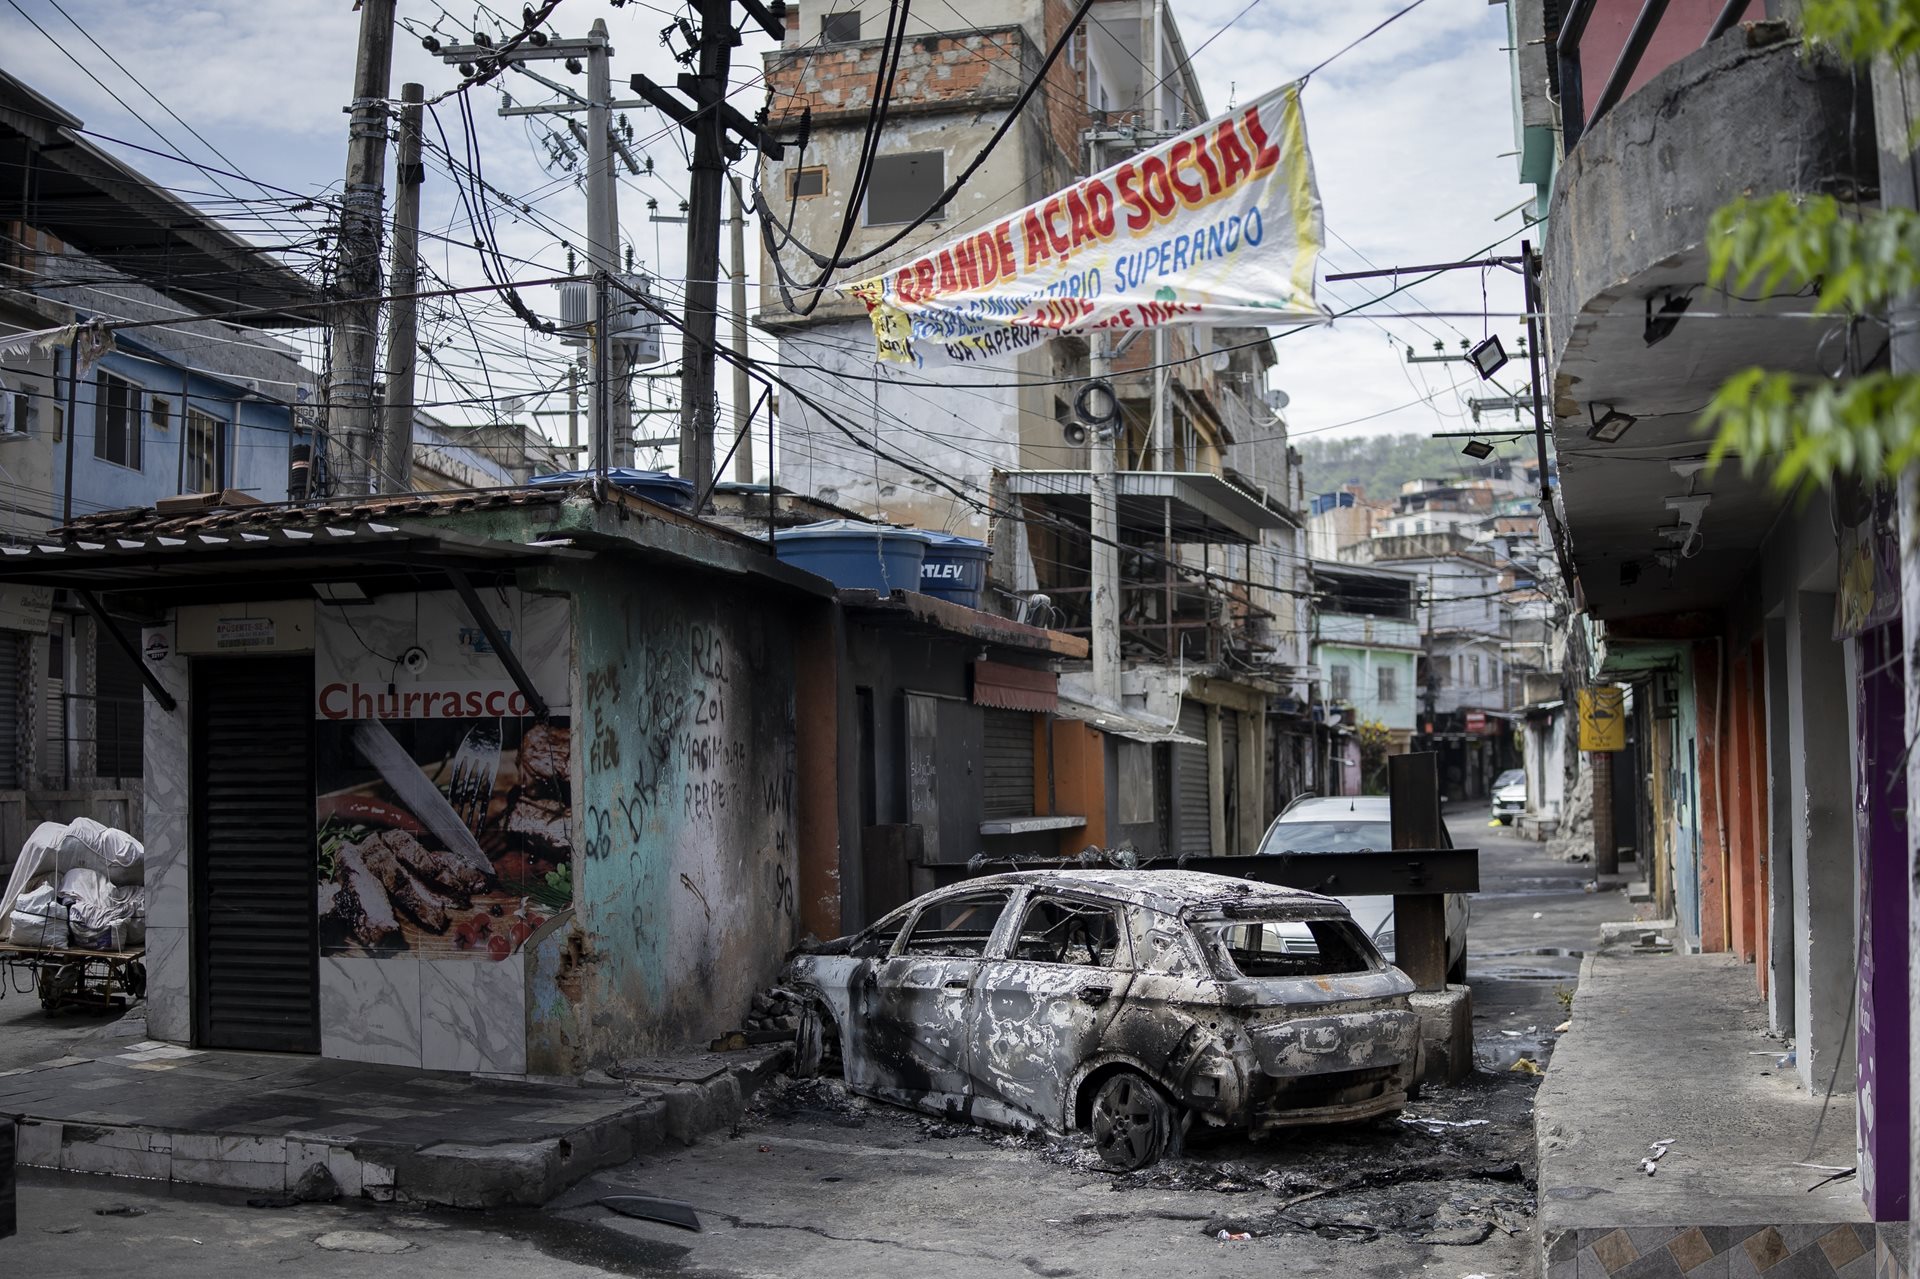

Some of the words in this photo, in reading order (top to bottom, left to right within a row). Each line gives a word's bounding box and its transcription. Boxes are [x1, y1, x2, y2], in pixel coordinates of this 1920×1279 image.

[896, 220, 1017, 303] GRANDE
[1024, 179, 1117, 262] AÇÃO
[1116, 105, 1281, 230] SOCIAL
[1115, 205, 1264, 293] SUPERANDO
[319, 683, 532, 719] Churrasco
